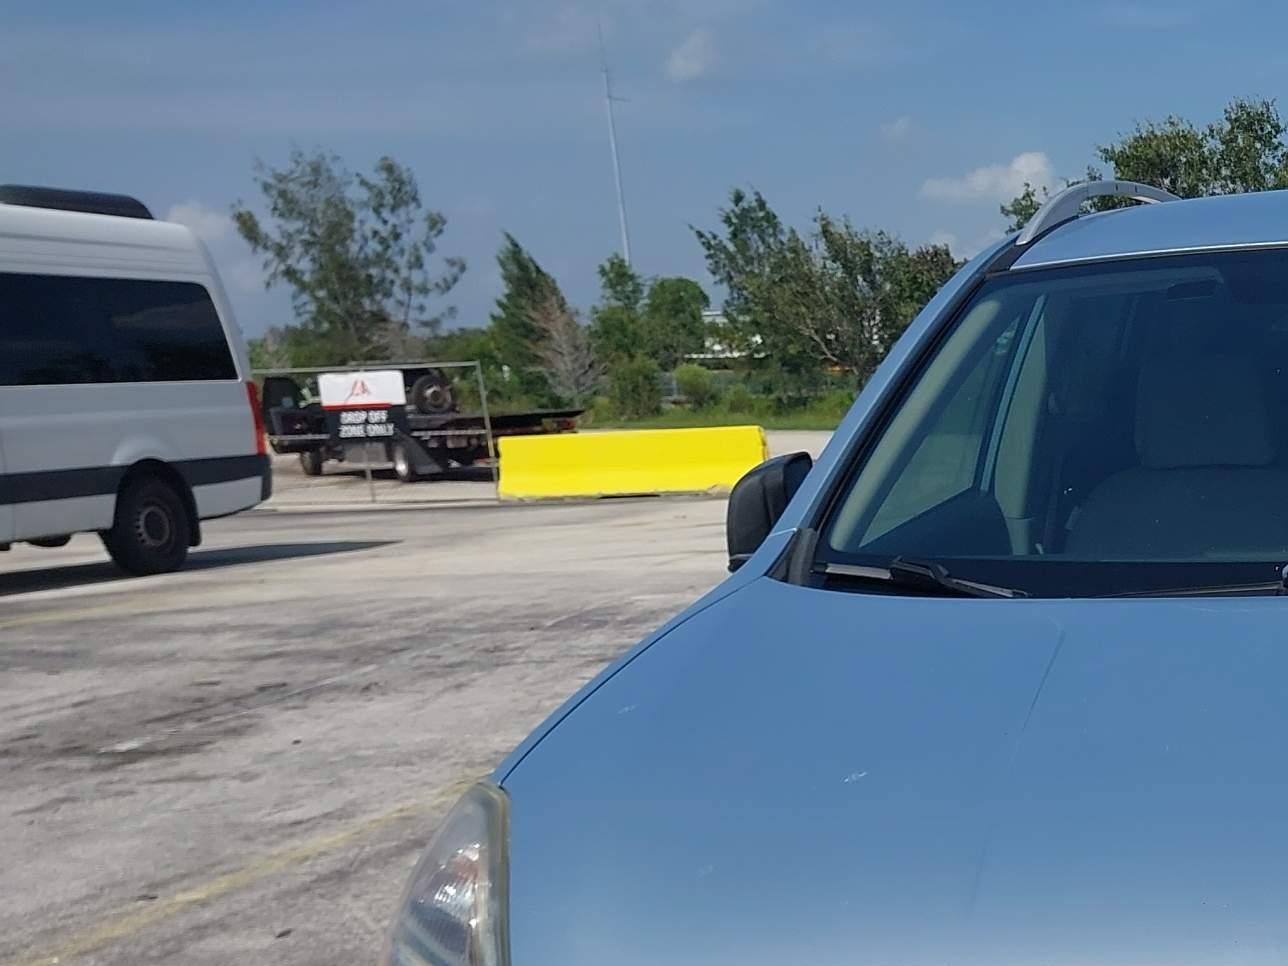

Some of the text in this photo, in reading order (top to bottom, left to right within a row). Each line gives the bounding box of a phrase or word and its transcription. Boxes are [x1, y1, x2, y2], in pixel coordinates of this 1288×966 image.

[341, 411, 387, 424] DROP OFF
[366, 424, 393, 436] ONLY
